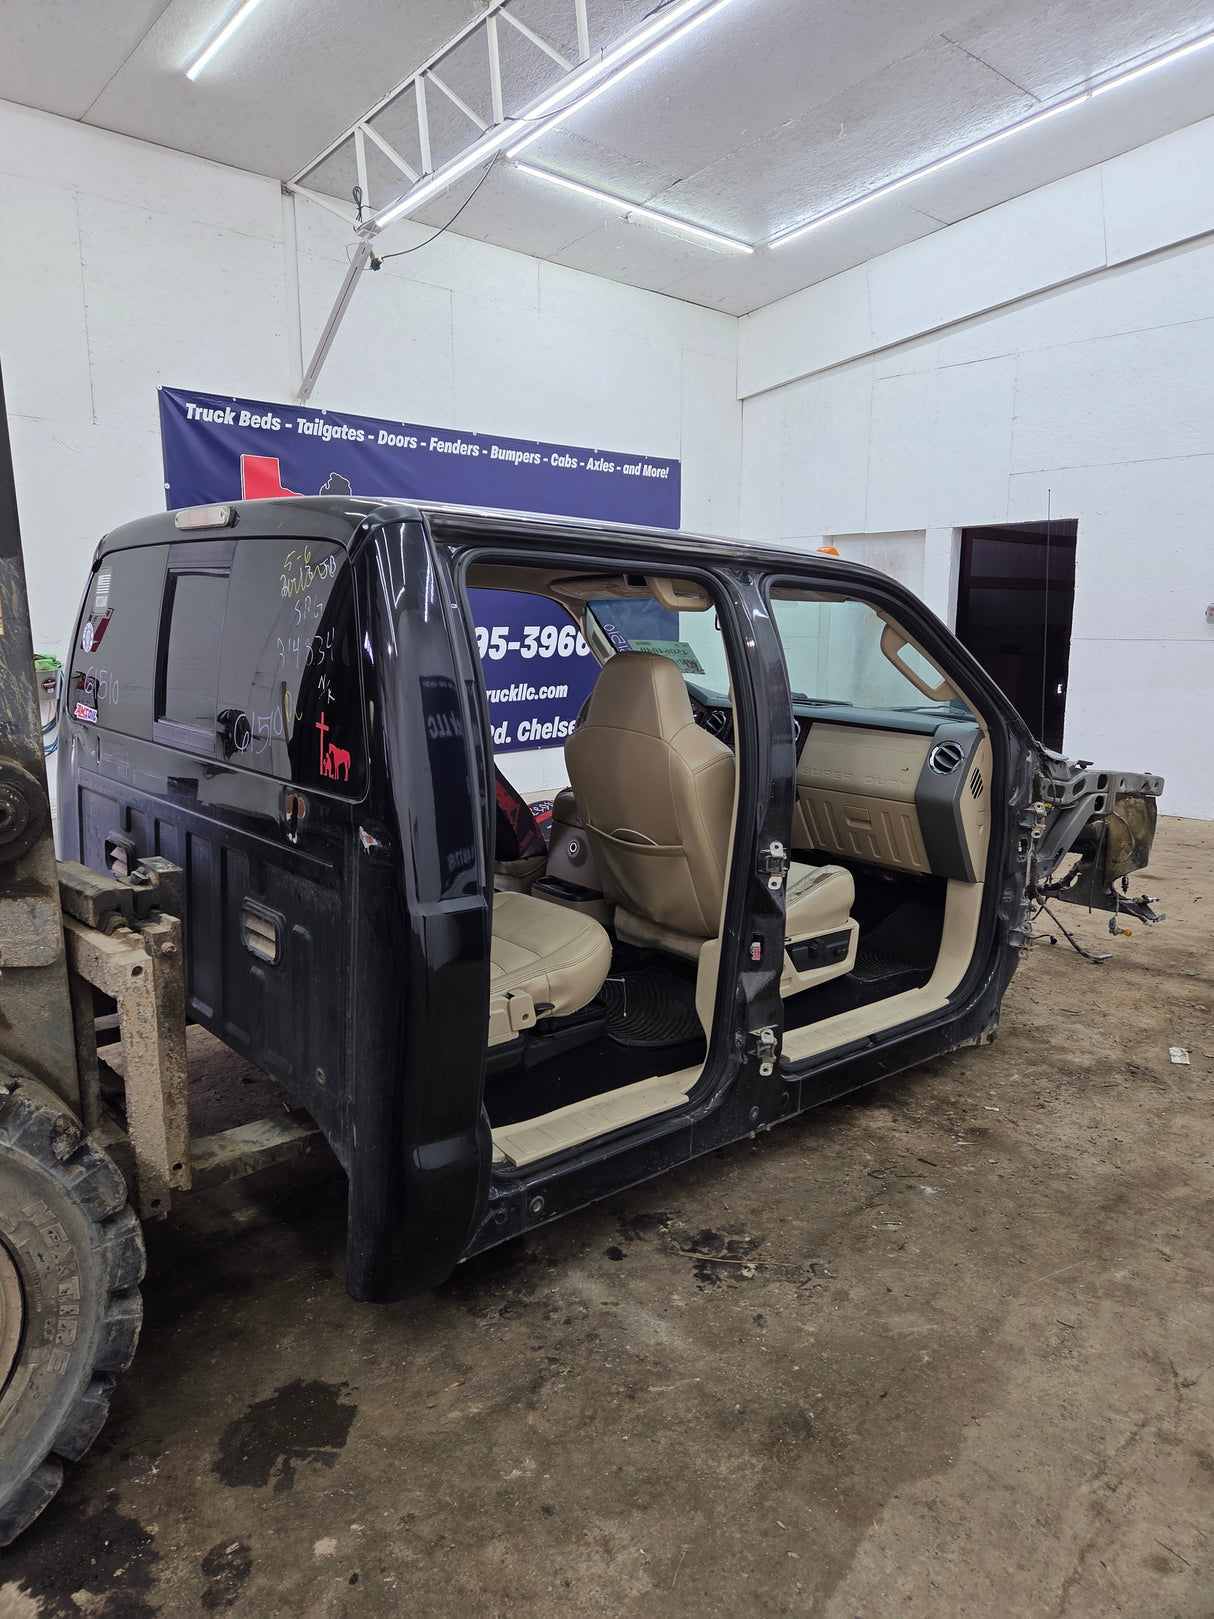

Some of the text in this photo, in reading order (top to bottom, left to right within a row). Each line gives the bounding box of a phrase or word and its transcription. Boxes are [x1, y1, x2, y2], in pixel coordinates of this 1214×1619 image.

[186, 403, 235, 425] Truck
[238, 410, 281, 431] Beds
[297, 418, 365, 441] Tailgates
[378, 430, 418, 449] Doors
[429, 437, 480, 457] Fenders
[490, 445, 541, 465] Bumpers
[551, 453, 577, 469] Cabs
[586, 457, 614, 473] Axles
[623, 463, 640, 476] and
[643, 464, 670, 478] More!
[490, 721, 512, 744] d.
